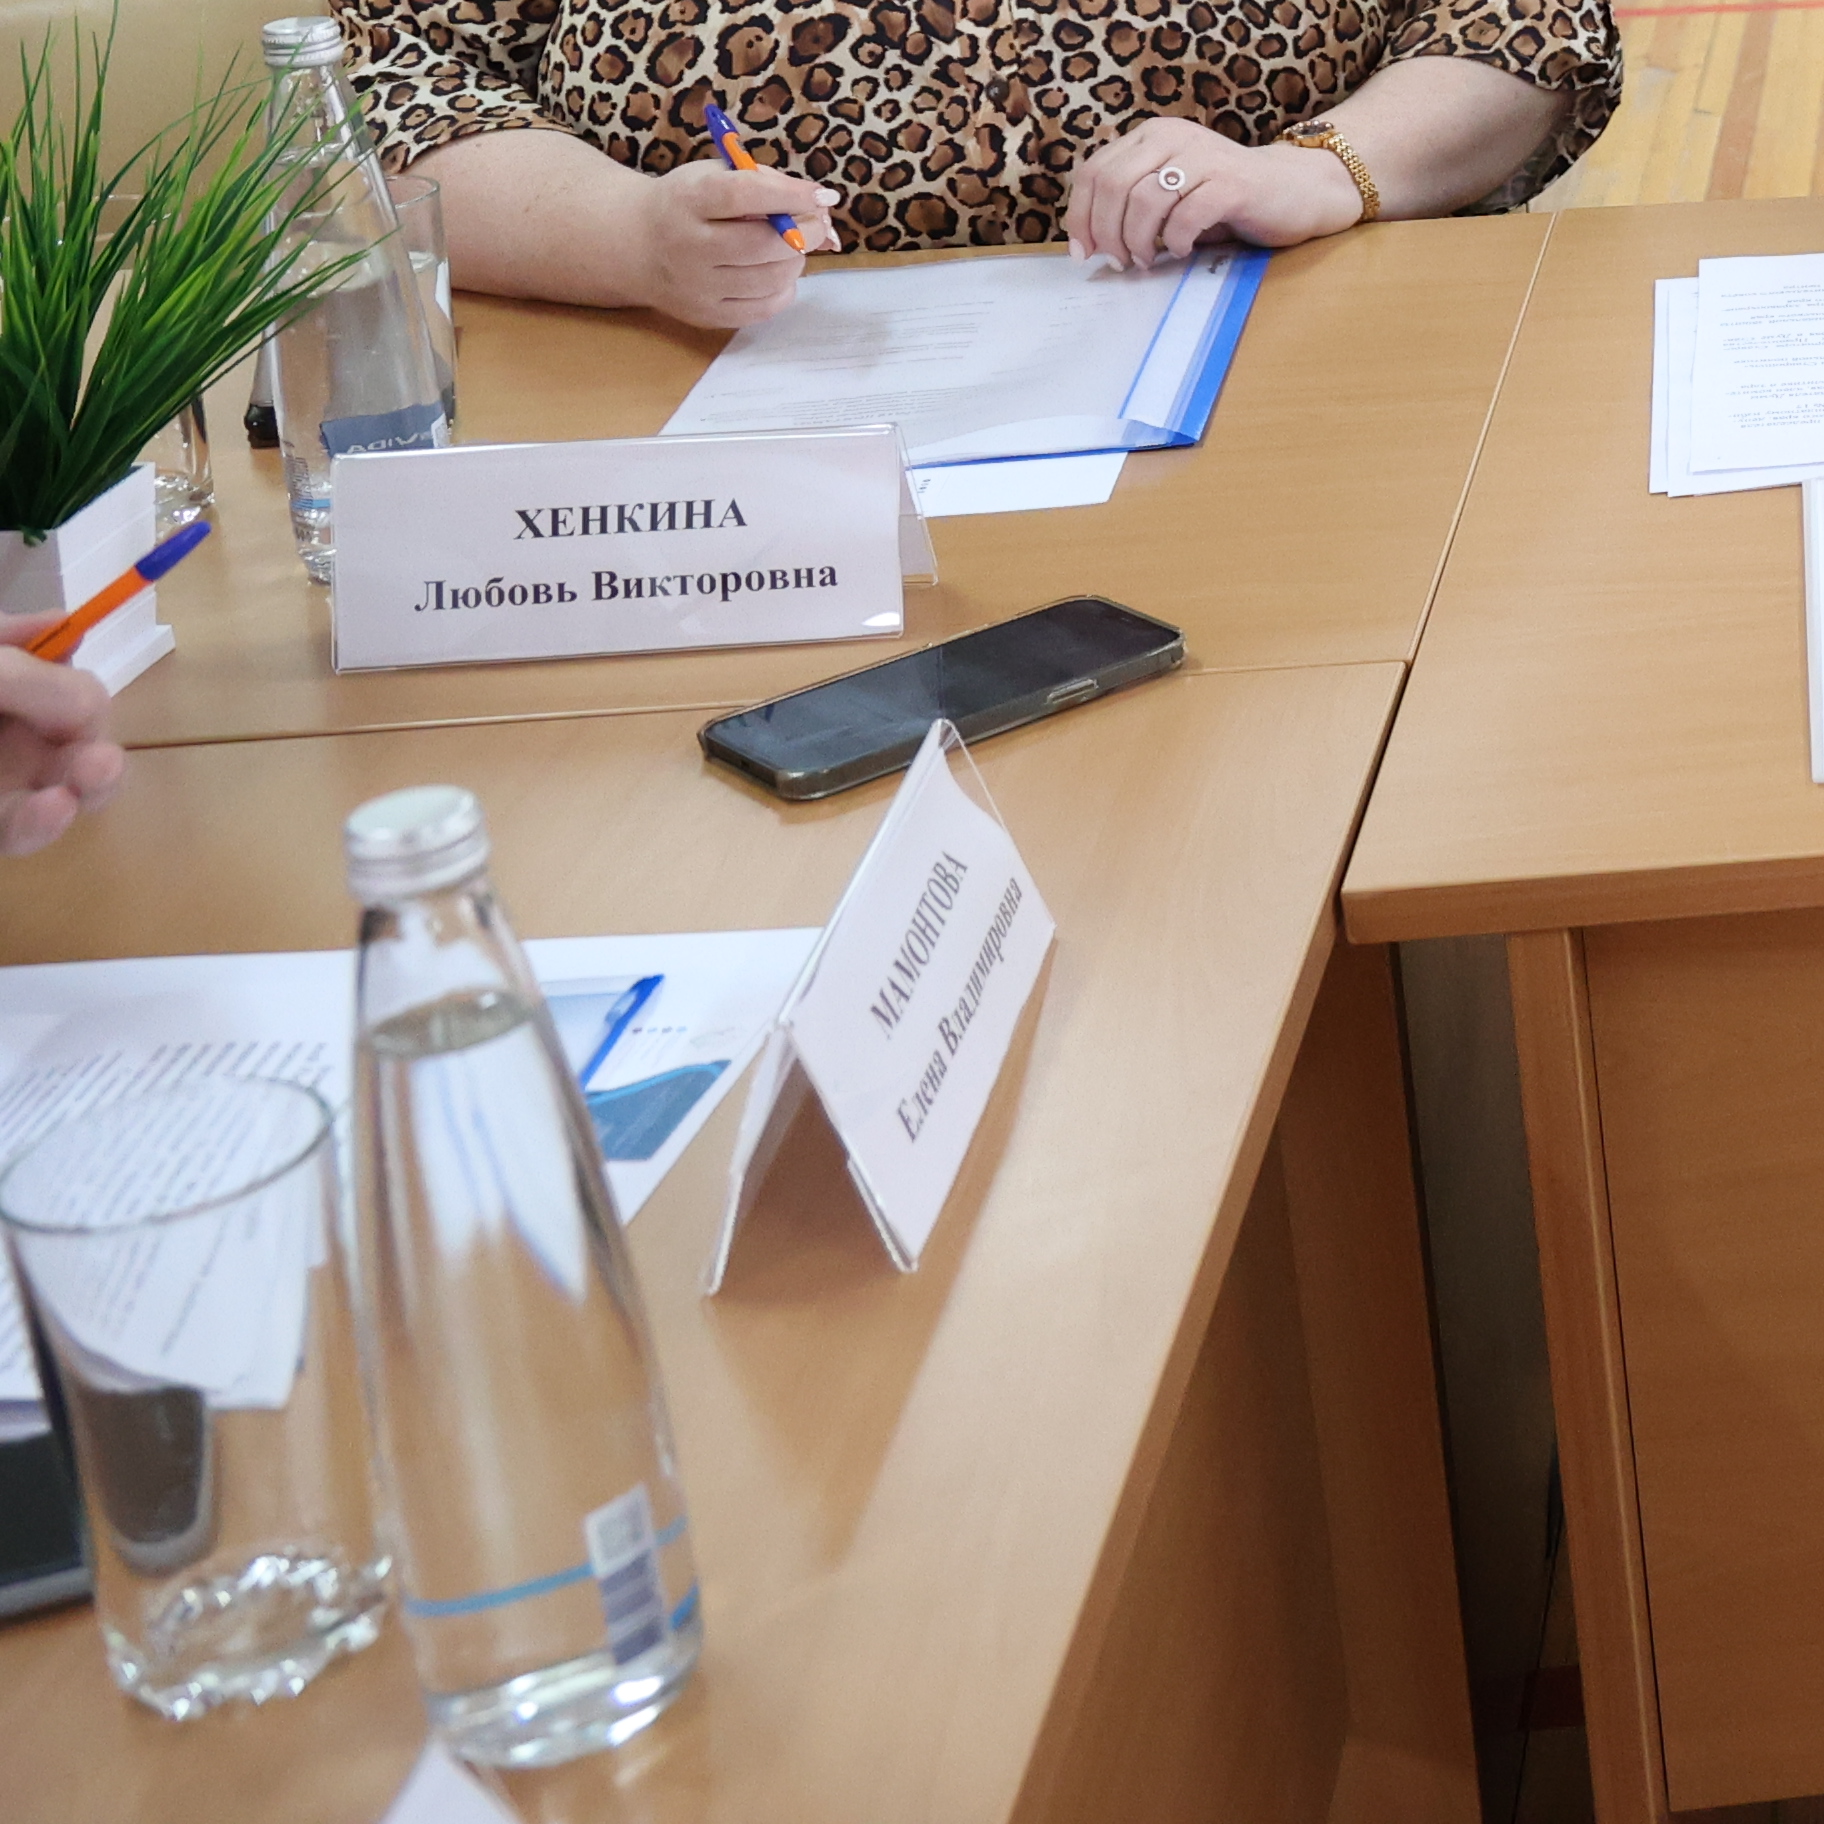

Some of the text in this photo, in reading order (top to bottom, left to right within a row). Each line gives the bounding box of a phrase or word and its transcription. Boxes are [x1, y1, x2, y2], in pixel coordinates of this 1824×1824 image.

[514, 497, 748, 540] ХЕНКИНА
[415, 564, 838, 612] Любовь Викторовна
[871, 851, 968, 1039] МАМОНТОВА
[898, 876, 1024, 1143] Елена Владимировна
